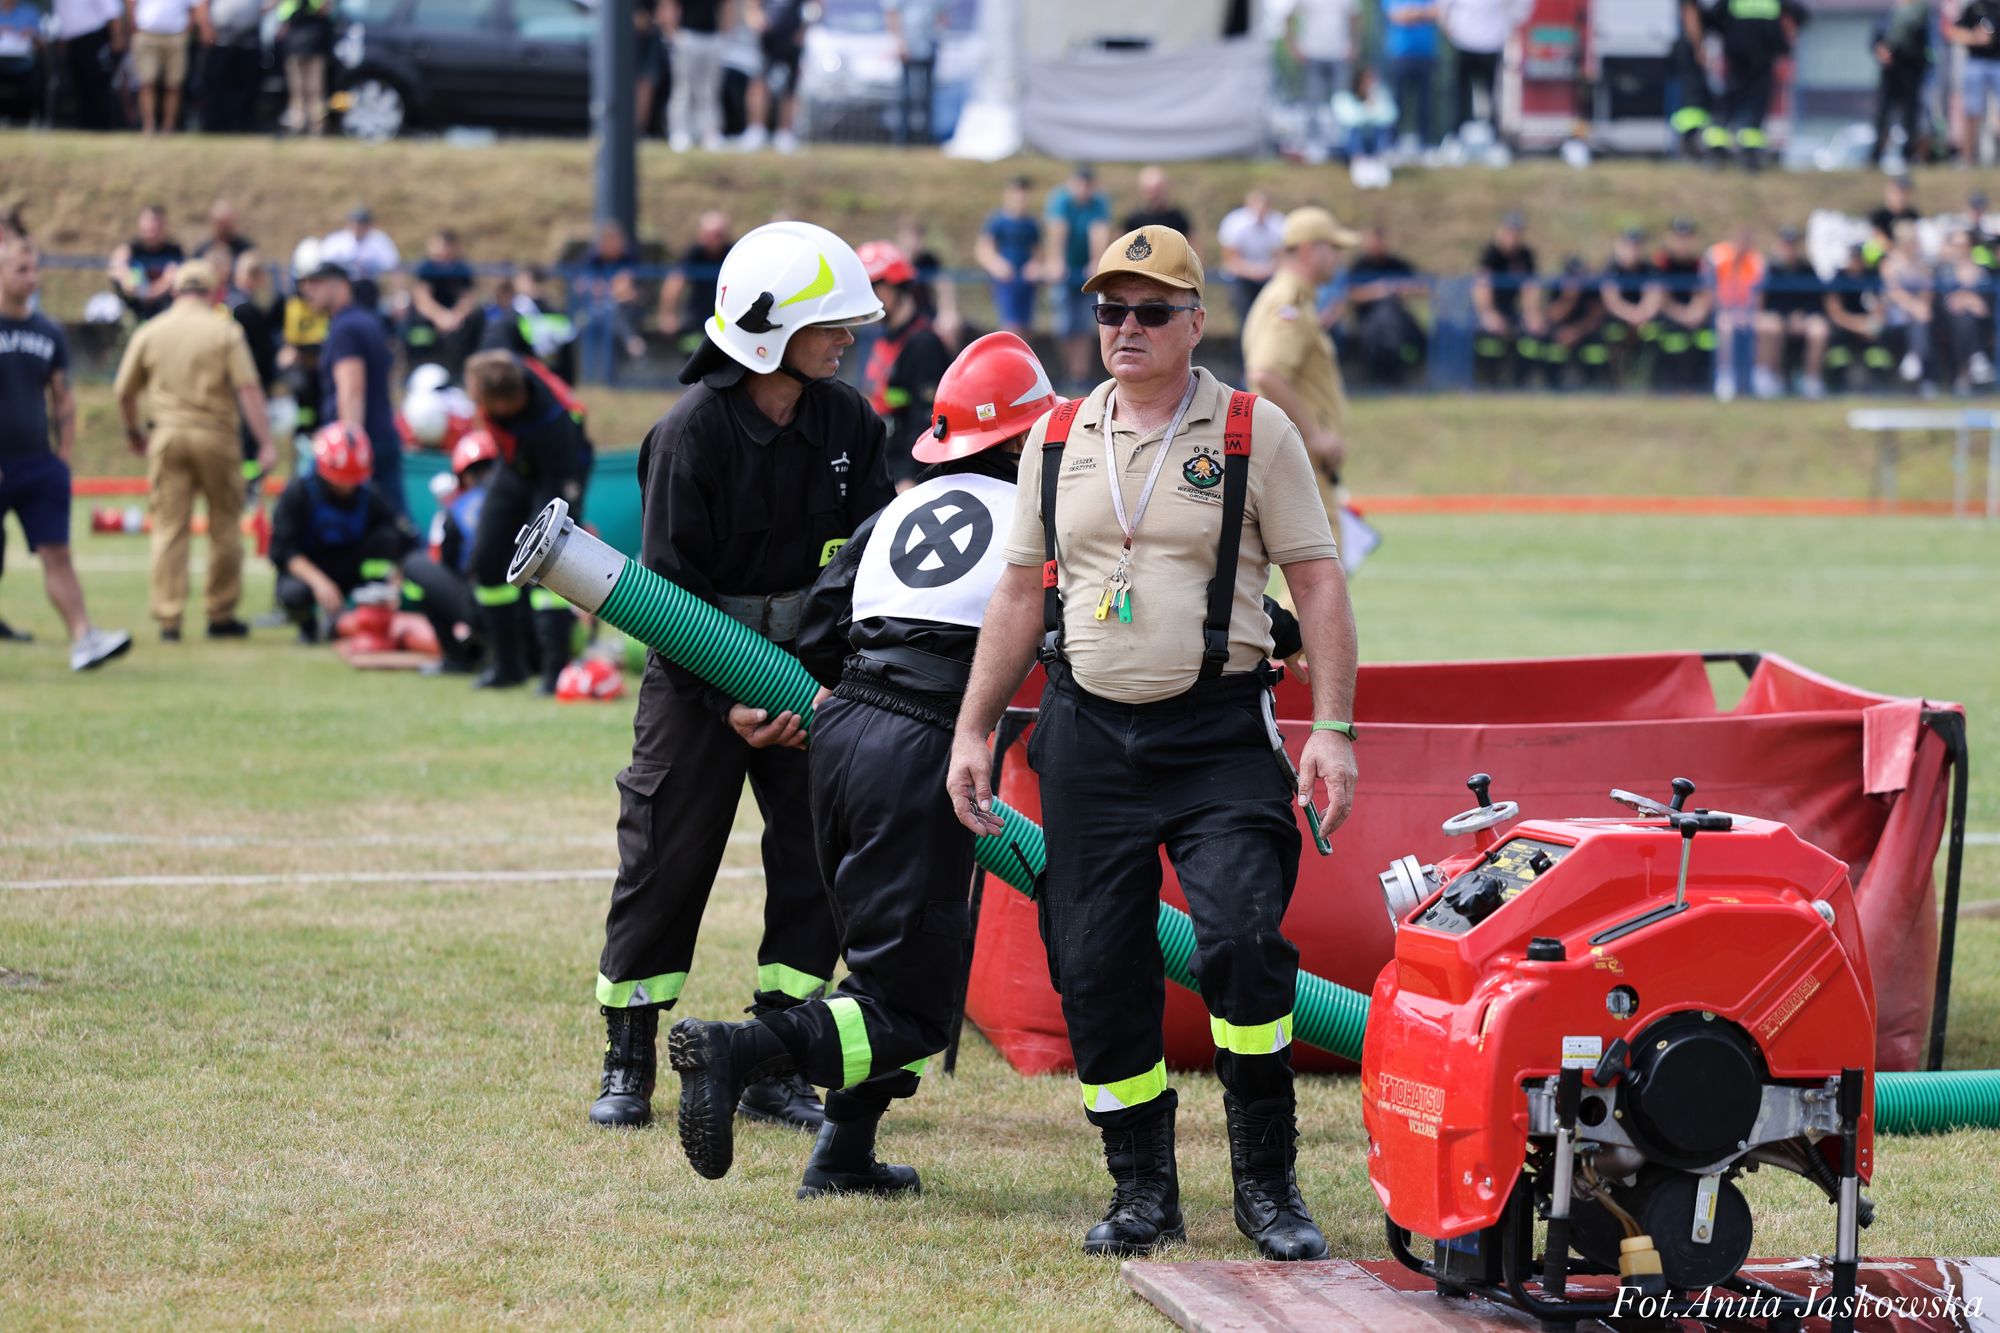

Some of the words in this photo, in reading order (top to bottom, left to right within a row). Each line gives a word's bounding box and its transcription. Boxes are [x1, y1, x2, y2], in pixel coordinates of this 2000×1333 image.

[1770, 973, 1818, 1025] TOHATSU
[1390, 1075, 1446, 1116] TOHATSU
[1392, 1102, 1421, 1119] FIGHTING
